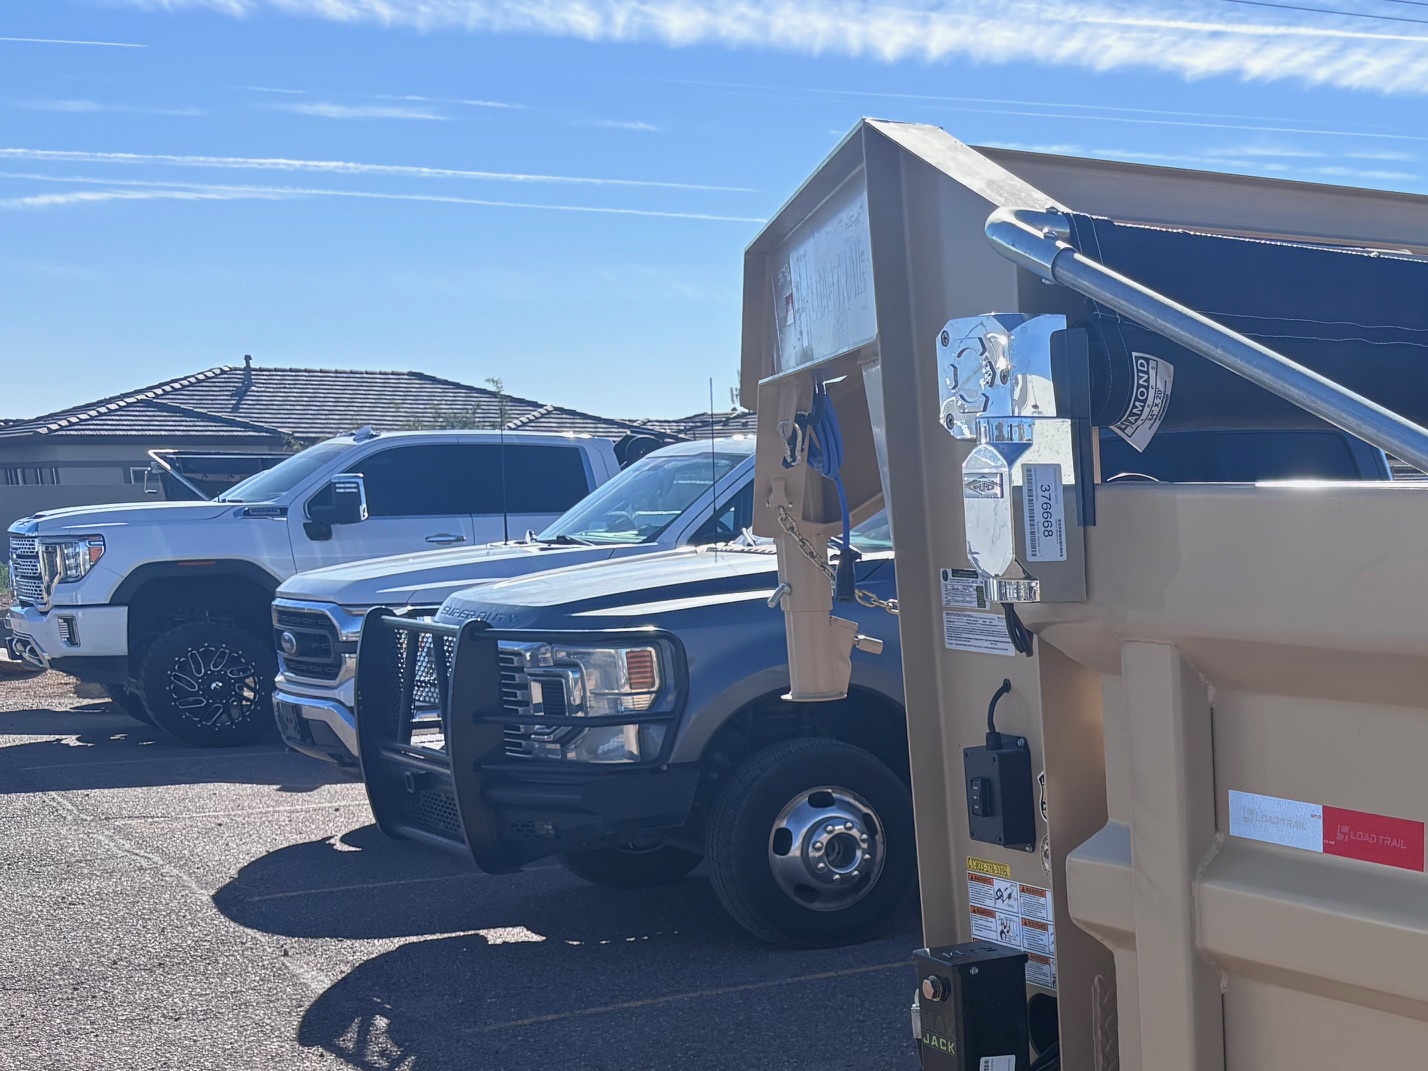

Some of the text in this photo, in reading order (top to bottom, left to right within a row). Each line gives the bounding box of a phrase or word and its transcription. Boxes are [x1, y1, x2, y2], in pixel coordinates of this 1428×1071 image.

[1040, 484, 1054, 538] 376668
[441, 606, 475, 620] SUPER
[1350, 831, 1376, 844] LOAD
[1377, 835, 1407, 850] TRAIL
[923, 1033, 956, 1055] JACK
